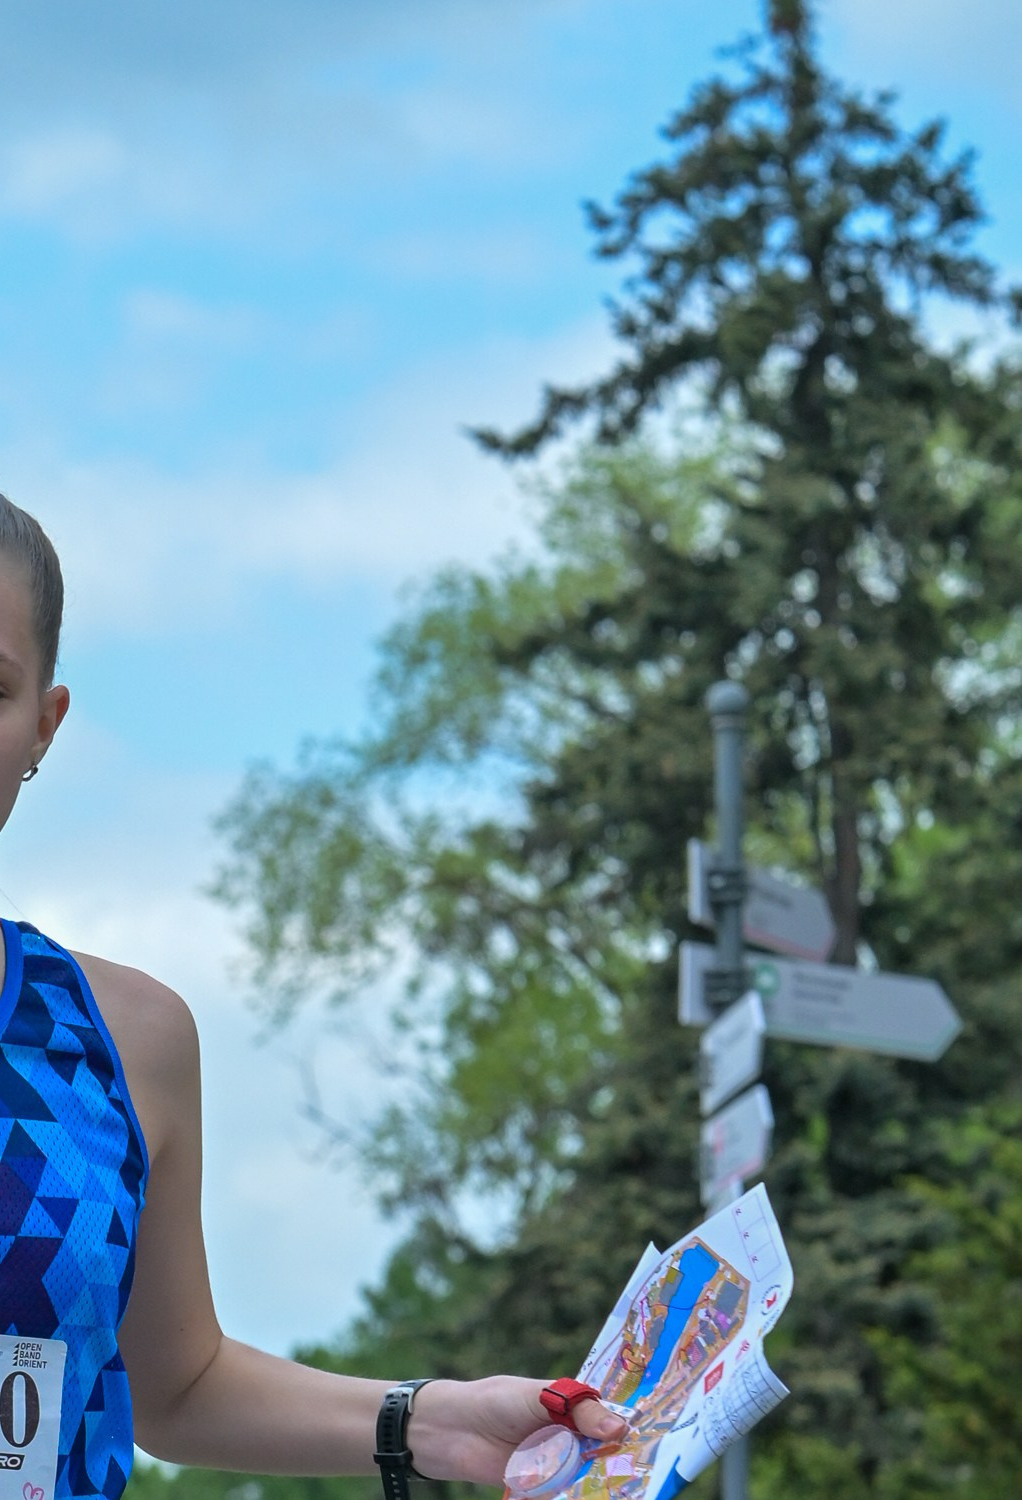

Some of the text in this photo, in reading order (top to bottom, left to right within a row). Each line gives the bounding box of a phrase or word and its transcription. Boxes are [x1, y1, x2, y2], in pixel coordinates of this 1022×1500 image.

[20, 1342, 43, 1351] OPEN
[19, 1350, 42, 1360] BAND
[18, 1359, 48, 1369] ORIENT
